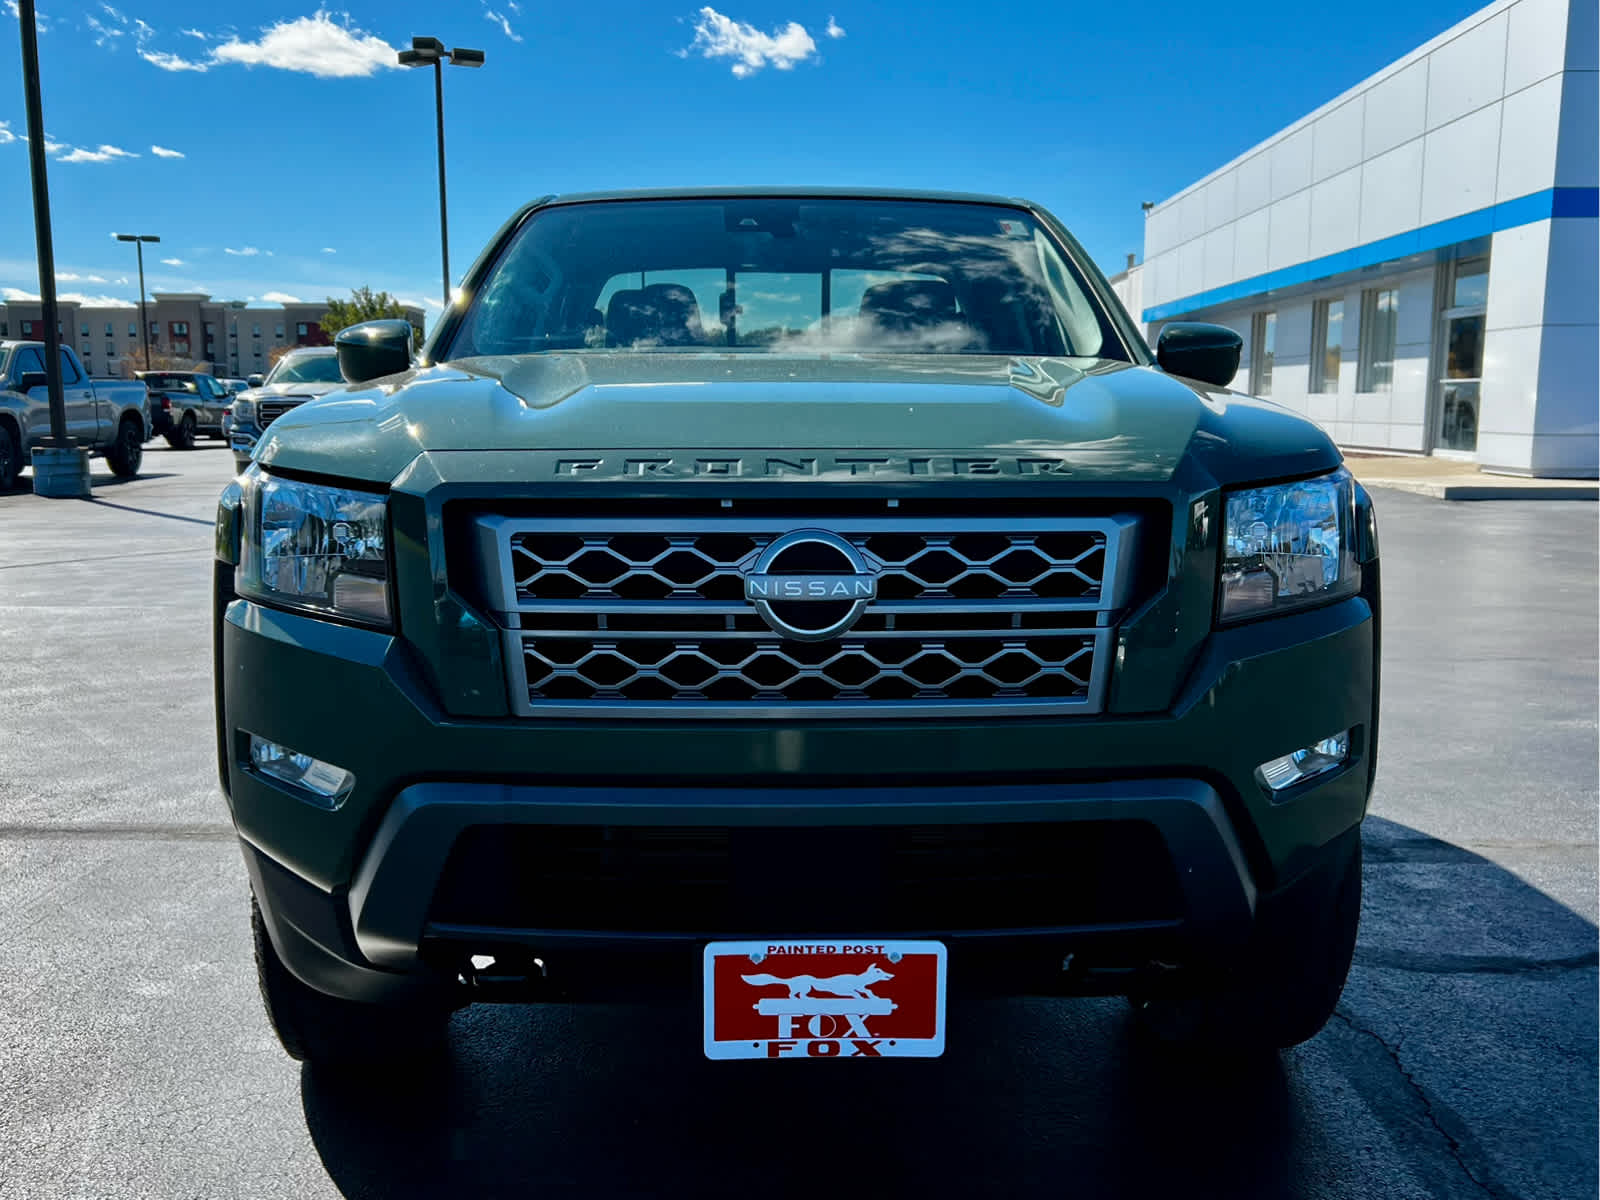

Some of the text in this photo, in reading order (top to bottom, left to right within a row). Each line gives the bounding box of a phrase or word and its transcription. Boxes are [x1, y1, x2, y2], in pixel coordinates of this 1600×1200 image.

[554, 458, 1073, 476] FRONTIER
[750, 580, 873, 596] NISSAN
[767, 945, 885, 954] PAINTED POST
[778, 1013, 872, 1038] FOX
[767, 1040, 882, 1057] FOX
